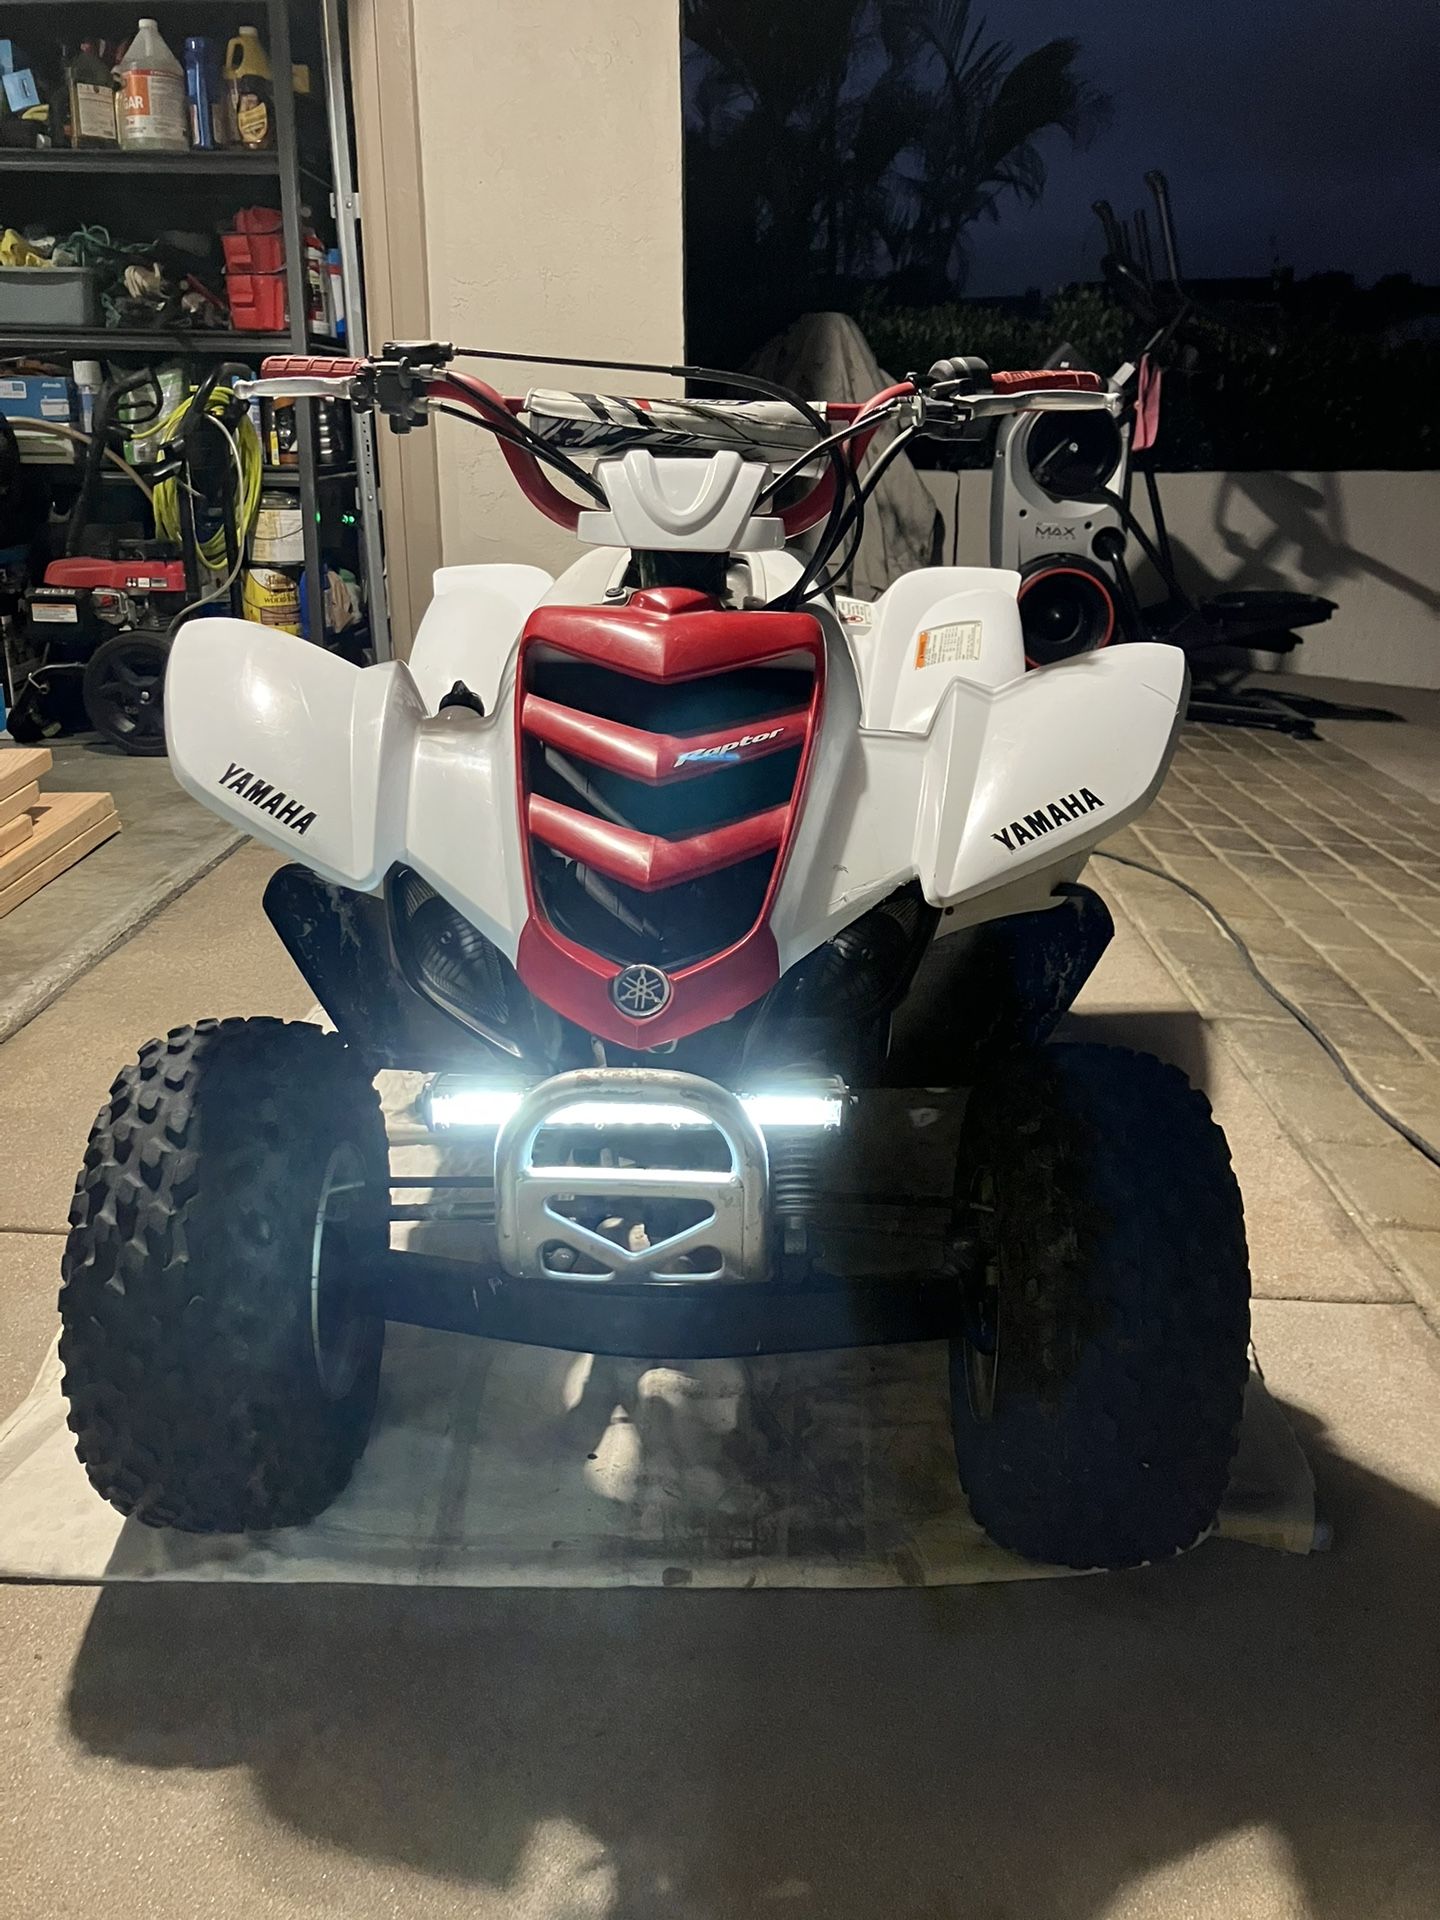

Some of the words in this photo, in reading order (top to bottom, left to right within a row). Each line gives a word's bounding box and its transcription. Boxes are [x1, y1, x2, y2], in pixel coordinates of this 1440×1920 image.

[1035, 526, 1076, 537] MAX
[673, 727, 784, 768] Raptor
[218, 762, 318, 836] YAMAHA
[990, 787, 1105, 851] YAMAHA
